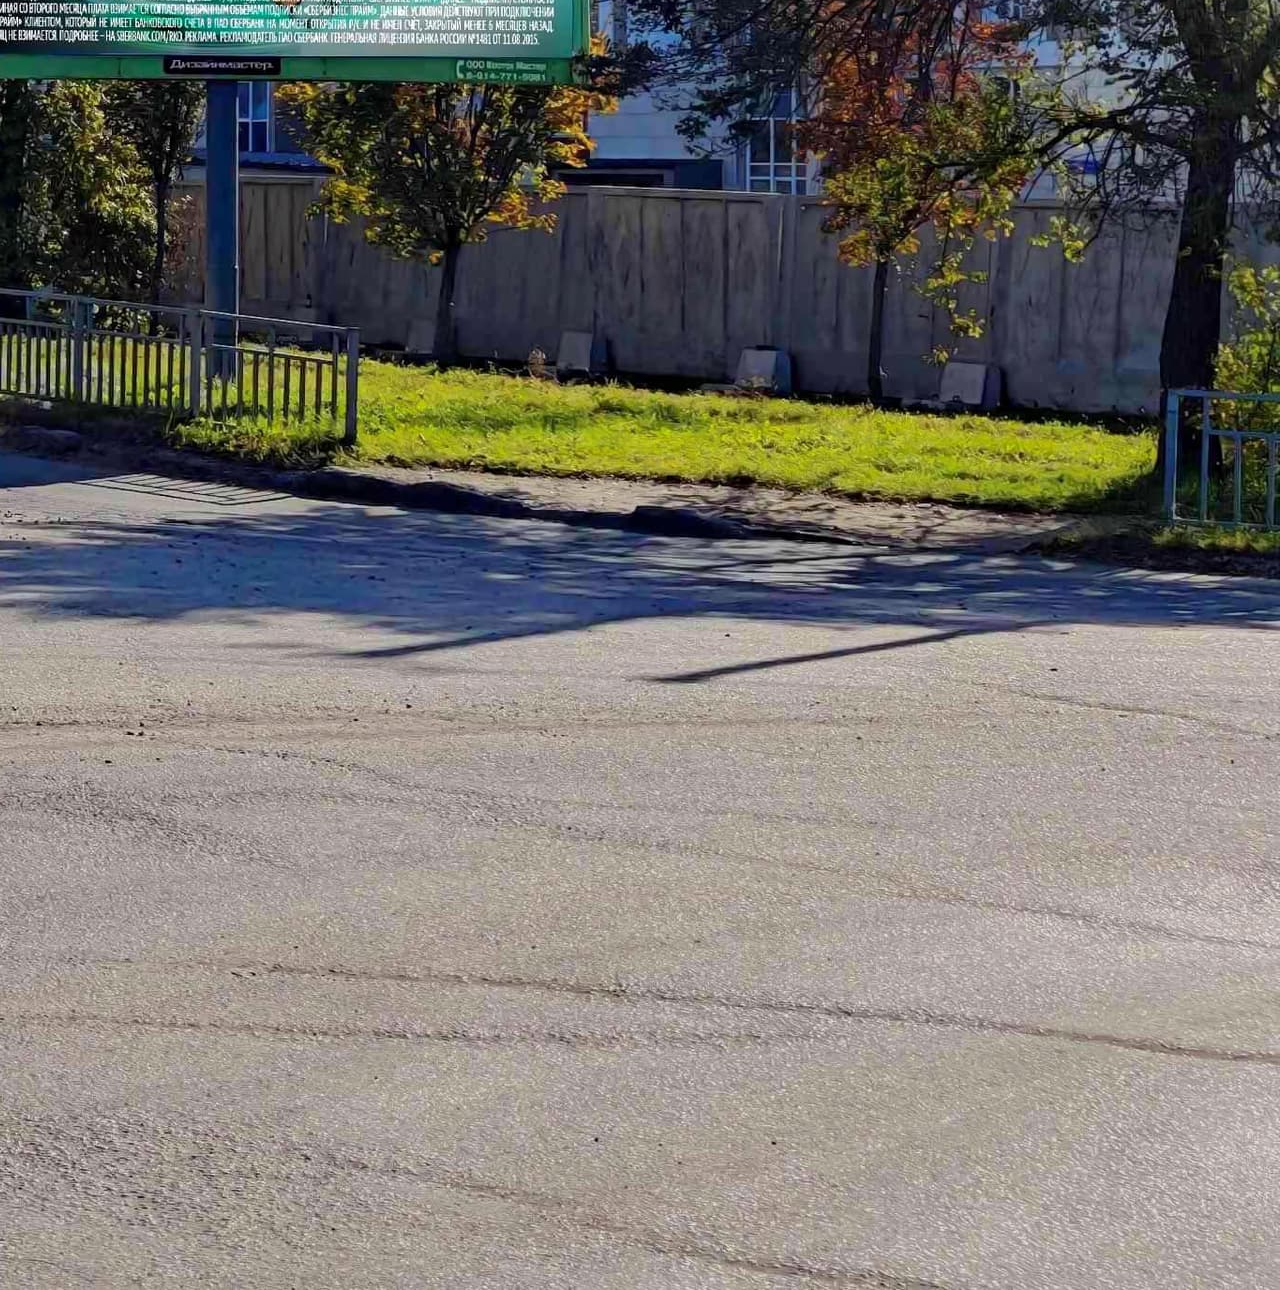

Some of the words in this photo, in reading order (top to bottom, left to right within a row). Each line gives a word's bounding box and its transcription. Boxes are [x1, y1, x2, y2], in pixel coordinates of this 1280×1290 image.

[29, 3, 58, 14] ВТОРОГО
[98, 18, 109, 28] НЕ
[110, 18, 134, 28] ИМЕЕТ
[8, 30, 18, 41] НЕ
[59, 31, 99, 43] ПОДРОБНЕЕ
[105, 31, 116, 41] НА
